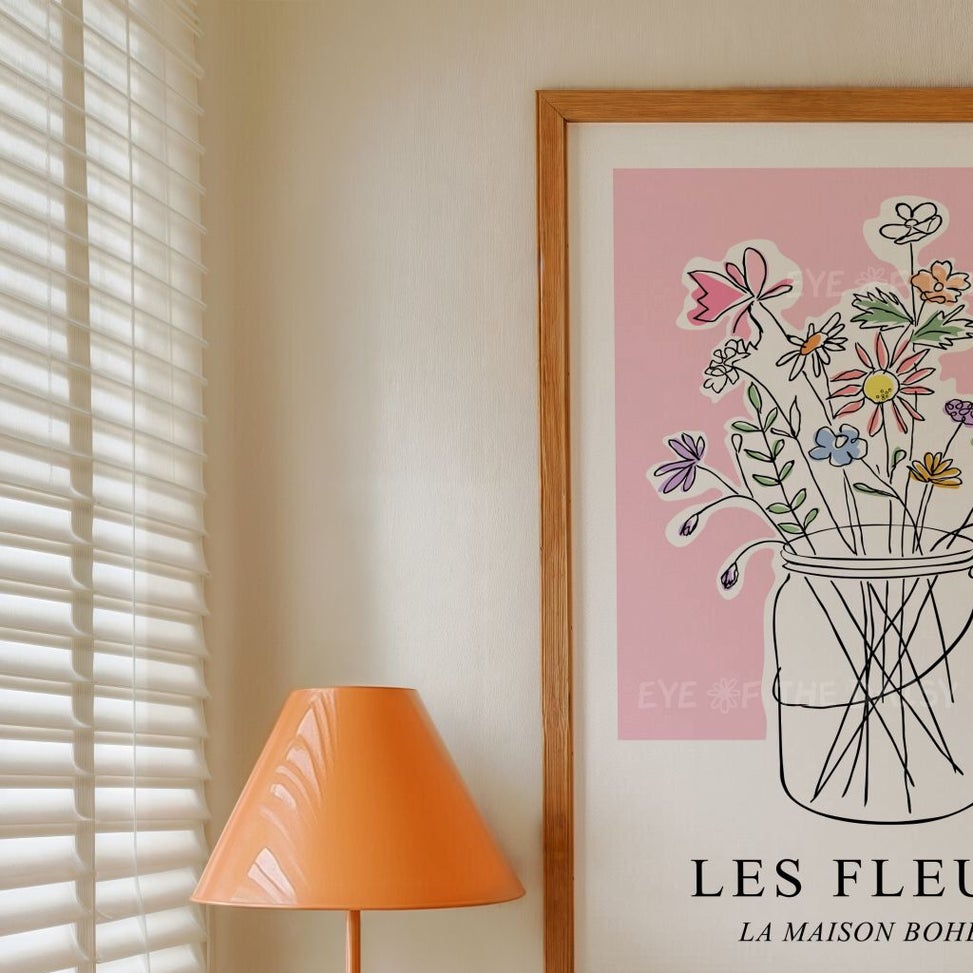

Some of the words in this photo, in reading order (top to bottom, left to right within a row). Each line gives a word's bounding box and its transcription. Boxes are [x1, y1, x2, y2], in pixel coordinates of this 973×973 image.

[690, 858, 802, 898] LES
[738, 921, 772, 942] LA
[782, 921, 896, 943] MAISON
